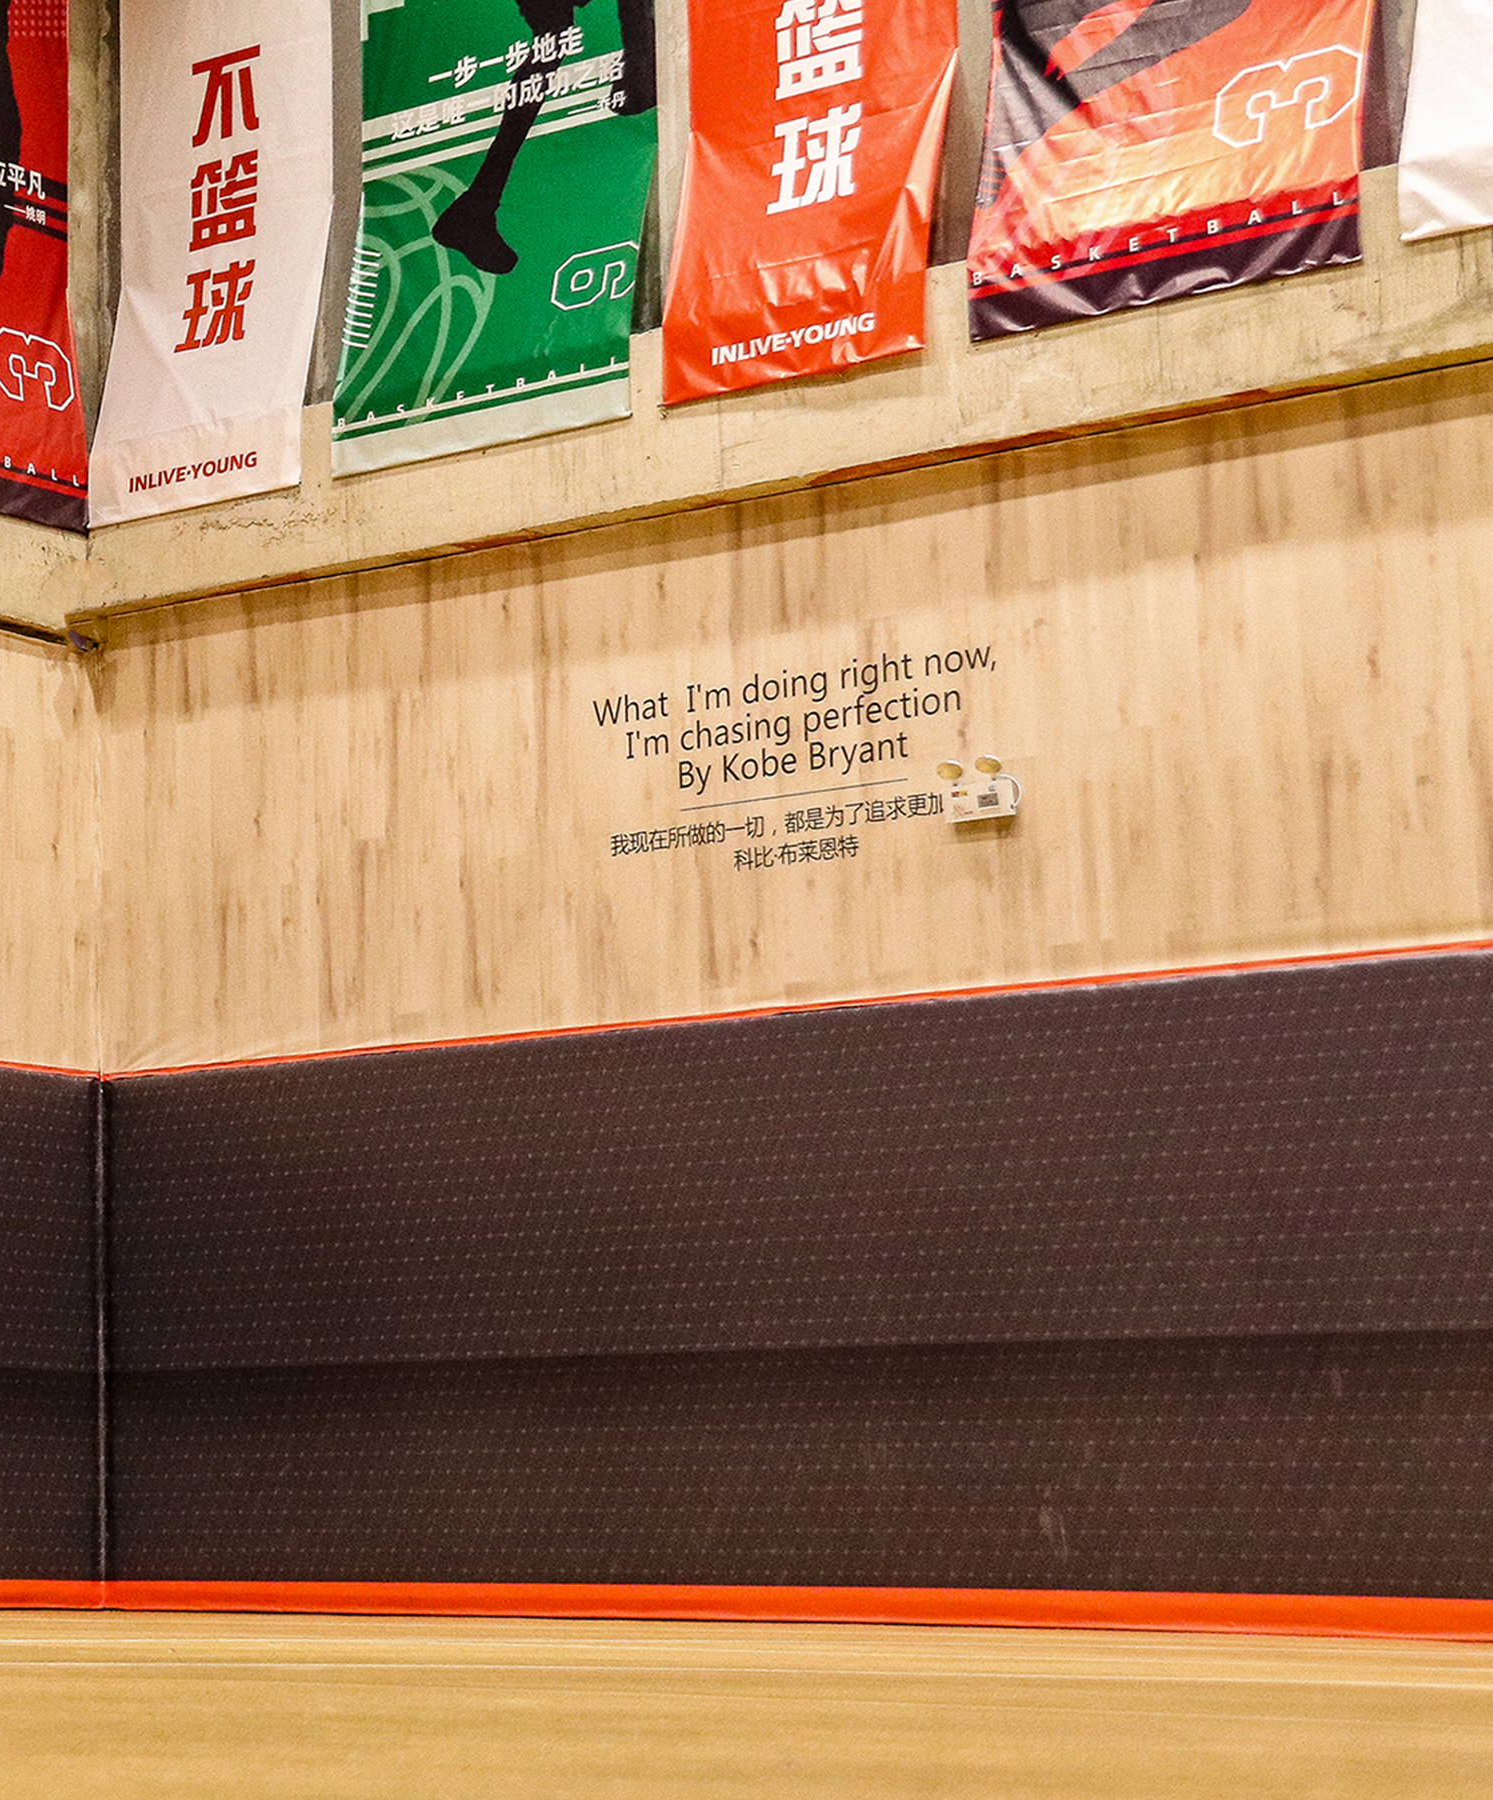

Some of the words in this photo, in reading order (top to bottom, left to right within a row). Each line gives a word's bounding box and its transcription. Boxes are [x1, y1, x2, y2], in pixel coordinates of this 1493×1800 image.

[428, 25, 585, 88] 一步一步地走
[391, 55, 626, 141] 这是唯一的成功之路
[173, 44, 261, 354] 不篮球
[972, 191, 1346, 287] BASKETBALL
[336, 356, 621, 428] BASKETBALL
[593, 692, 669, 727] What
[686, 684, 731, 713] I'm
[742, 670, 827, 703] doing
[840, 652, 913, 696] right
[925, 645, 997, 677] now,
[626, 730, 670, 760] I'm
[680, 713, 791, 747] chasing
[804, 687, 962, 742] perfection
[678, 760, 712, 795] By
[723, 747, 797, 784] Kobe
[810, 732, 909, 776] Bryant
